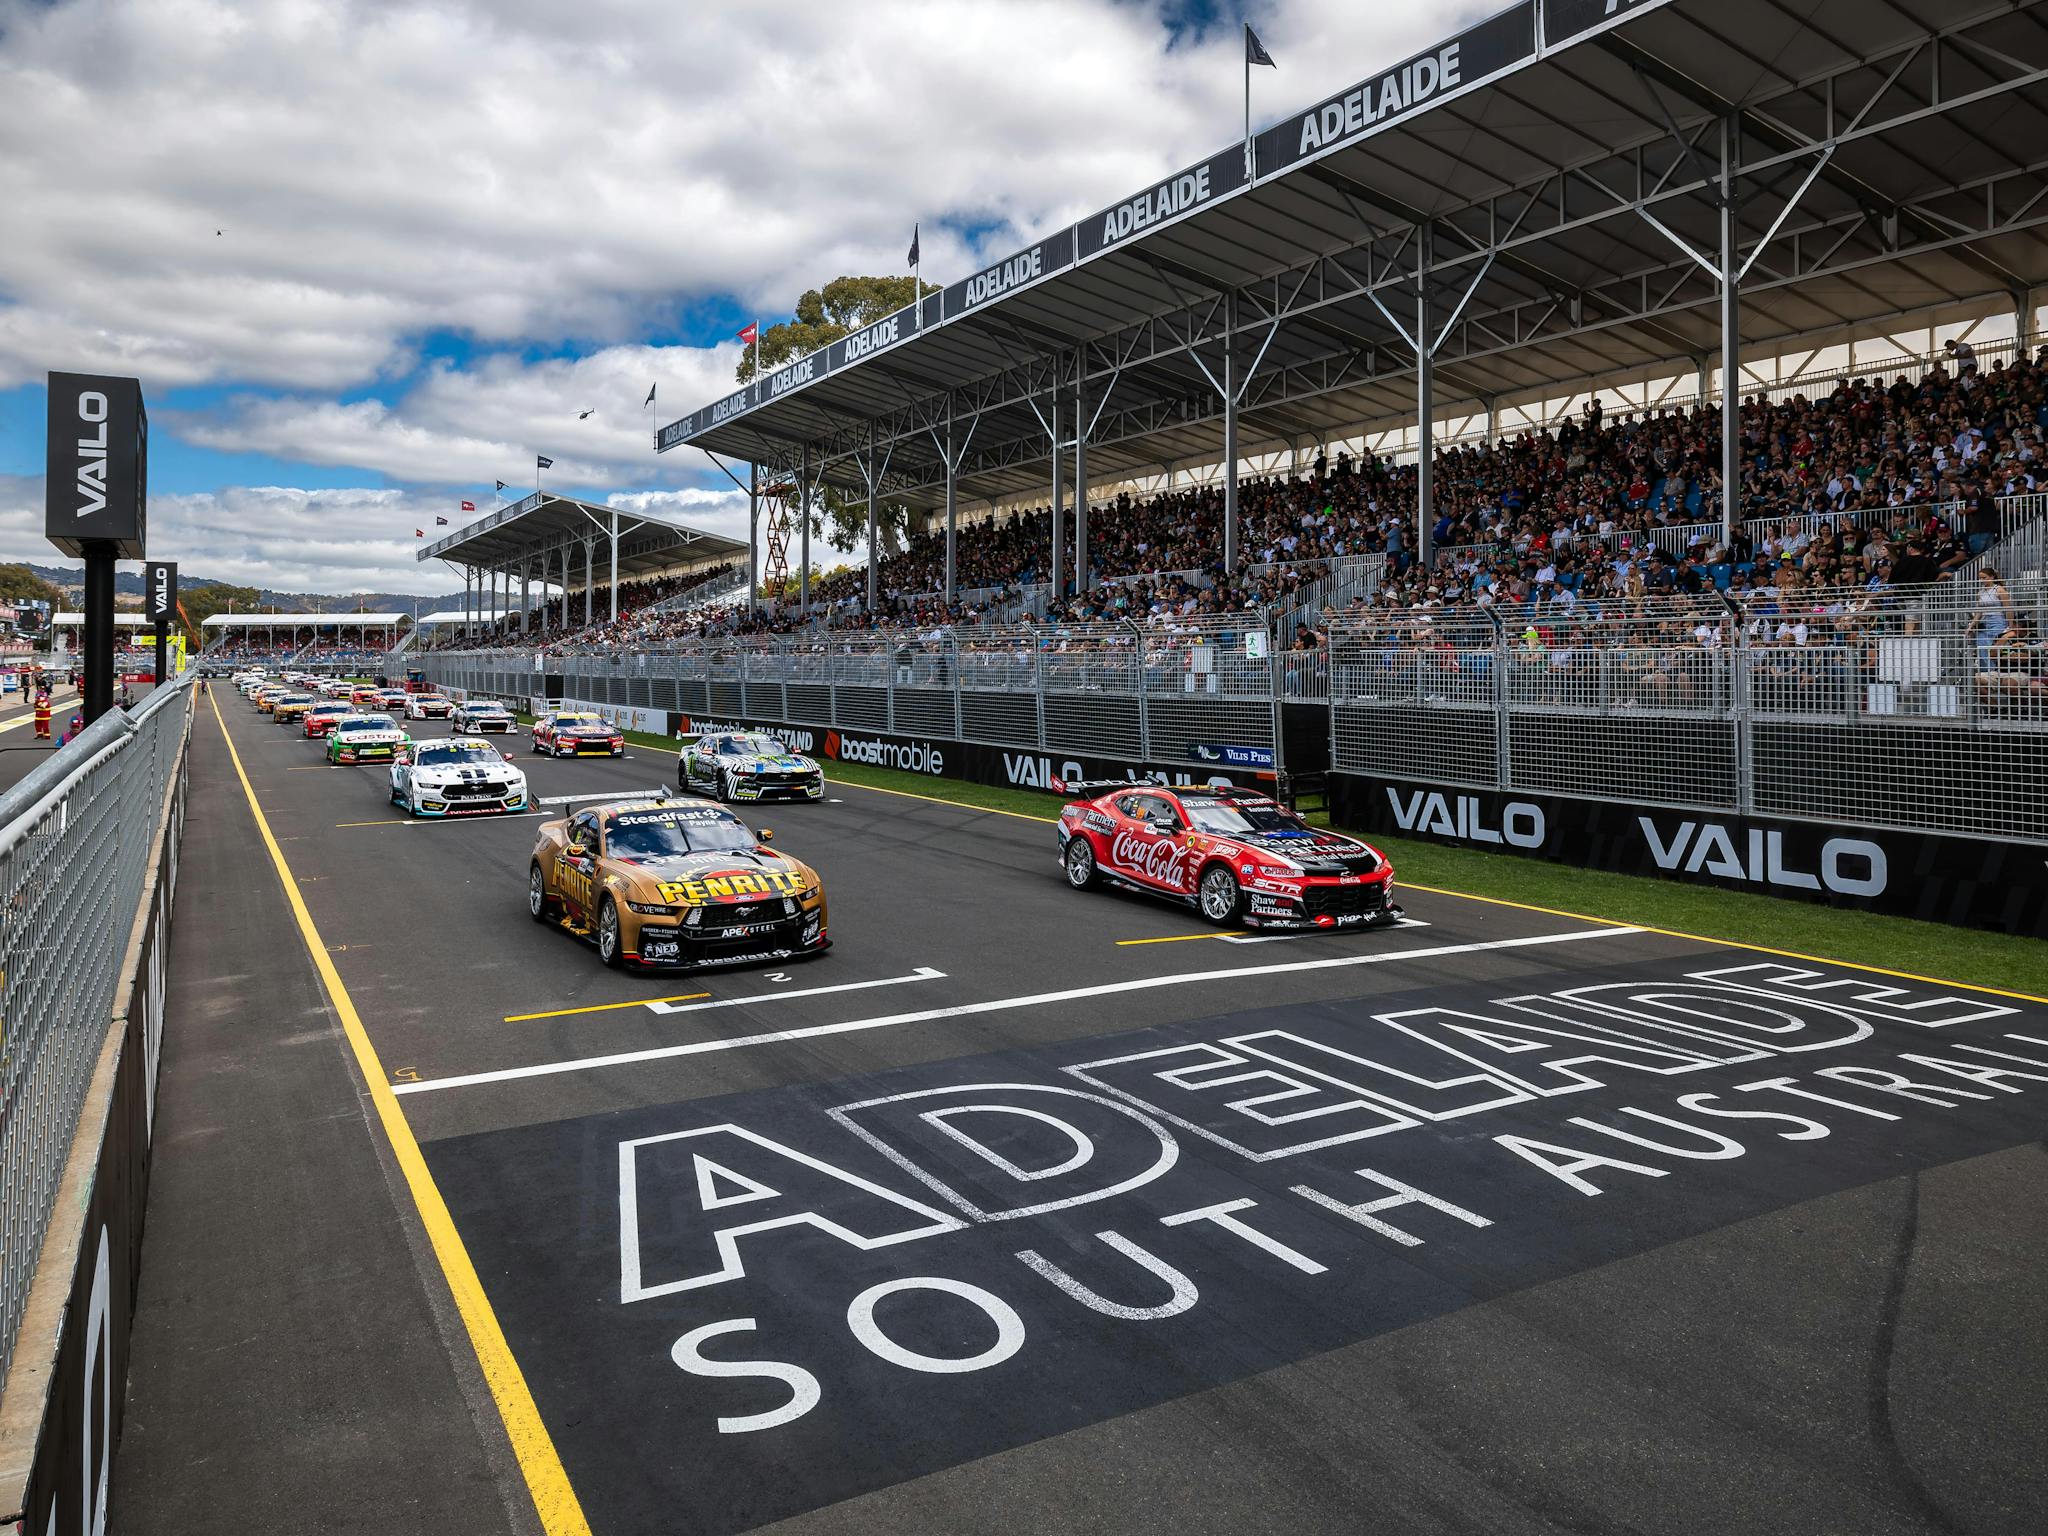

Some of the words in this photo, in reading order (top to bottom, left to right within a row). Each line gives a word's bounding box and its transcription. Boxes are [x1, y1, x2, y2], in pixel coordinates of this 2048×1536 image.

[1300, 42, 1460, 155] ADELAIDE
[1103, 165, 1210, 246] ADELAIDE
[965, 247, 1041, 307] ADELAIDE
[844, 317, 898, 362] ADELAIDE
[771, 358, 813, 396] ADELAIDE
[712, 391, 746, 423] ADELAIDE
[664, 418, 692, 444] ADELAIDE
[77, 391, 108, 518] VAILO
[156, 568, 168, 614] VAILO
[777, 729, 813, 751] STAND
[841, 734, 943, 774] boostmobile
[1250, 751, 1271, 763] PIES
[618, 811, 702, 826] Steadfast
[1086, 809, 1117, 828] Partners
[1181, 800, 1215, 808] Shaw
[1386, 787, 1545, 848] VAILO
[689, 819, 716, 827] Payne
[1639, 817, 1887, 897] VAILO
[552, 857, 593, 910] PENRITE
[657, 871, 808, 905] PENRITE
[1254, 878, 1301, 894] SCTR
[630, 903, 654, 914] GROVE
[1251, 894, 1276, 905] Shaw
[1251, 904, 1293, 915] Partners
[722, 926, 750, 938] APEX
[752, 924, 776, 933] STEEL
[1337, 914, 1363, 926] Pizza
[1363, 911, 1377, 922] Hut
[655, 944, 679, 955] NED
[698, 951, 774, 965] Steadfast
[618, 963, 2024, 1304] ADELAIDE
[671, 1168, 1494, 1434] SOUTH
[1492, 1033, 2048, 1197] AUSTRA
